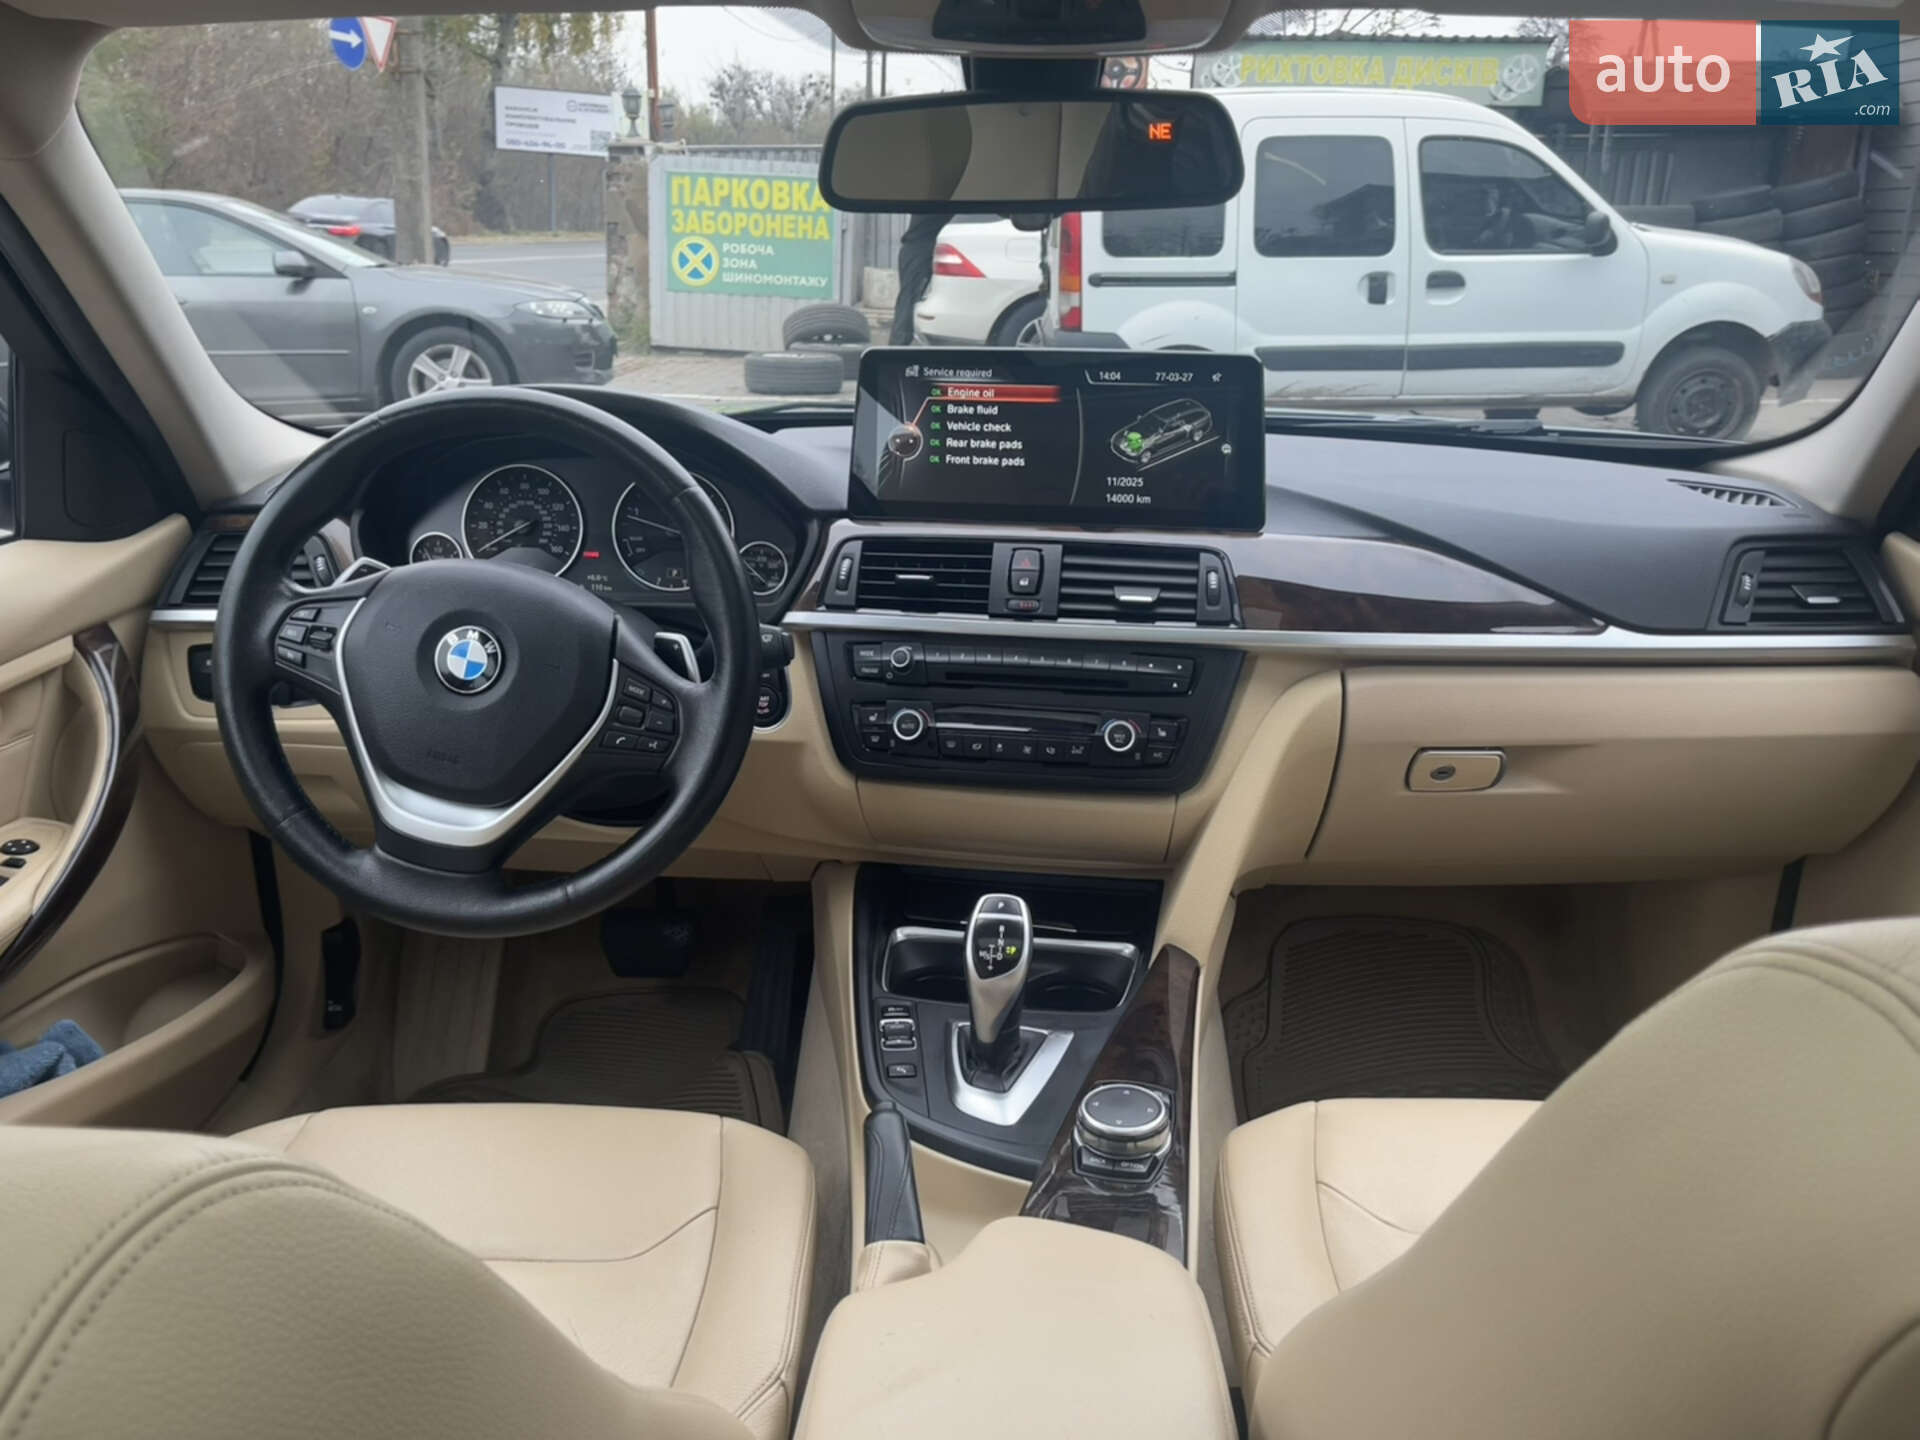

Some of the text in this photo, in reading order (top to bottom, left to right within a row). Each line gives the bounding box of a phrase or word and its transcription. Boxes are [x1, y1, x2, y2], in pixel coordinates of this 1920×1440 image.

[1240, 54, 1499, 89] РИХТОВКА ДИСКІВ
[1149, 122, 1173, 140] NE
[671, 175, 832, 213] ПАРКОВКА
[671, 208, 831, 240] ЗАБОРОНЕНА
[722, 242, 775, 256] РОБОЧА
[722, 257, 758, 270] ЗОНА
[722, 271, 828, 288] ШИНОМОНТАЖУ
[923, 367, 993, 379] Service required
[1099, 371, 1121, 381] 14:04
[1155, 371, 1194, 382] 77-03-27
[947, 386, 981, 398] Engine
[983, 388, 995, 398] oil
[947, 404, 975, 415] Brake
[977, 405, 999, 415] fluid
[946, 421, 981, 432] Vehicle
[983, 422, 1012, 432] check
[946, 438, 968, 448] Rear
[970, 438, 997, 449] brake
[999, 440, 1023, 451] pads
[945, 454, 971, 465] Front
[972, 455, 999, 466] brake
[1001, 456, 1025, 468] pads
[1106, 476, 1144, 487] 11/2025
[1106, 493, 1151, 504] 14000 km
[447, 629, 497, 654] BMW
